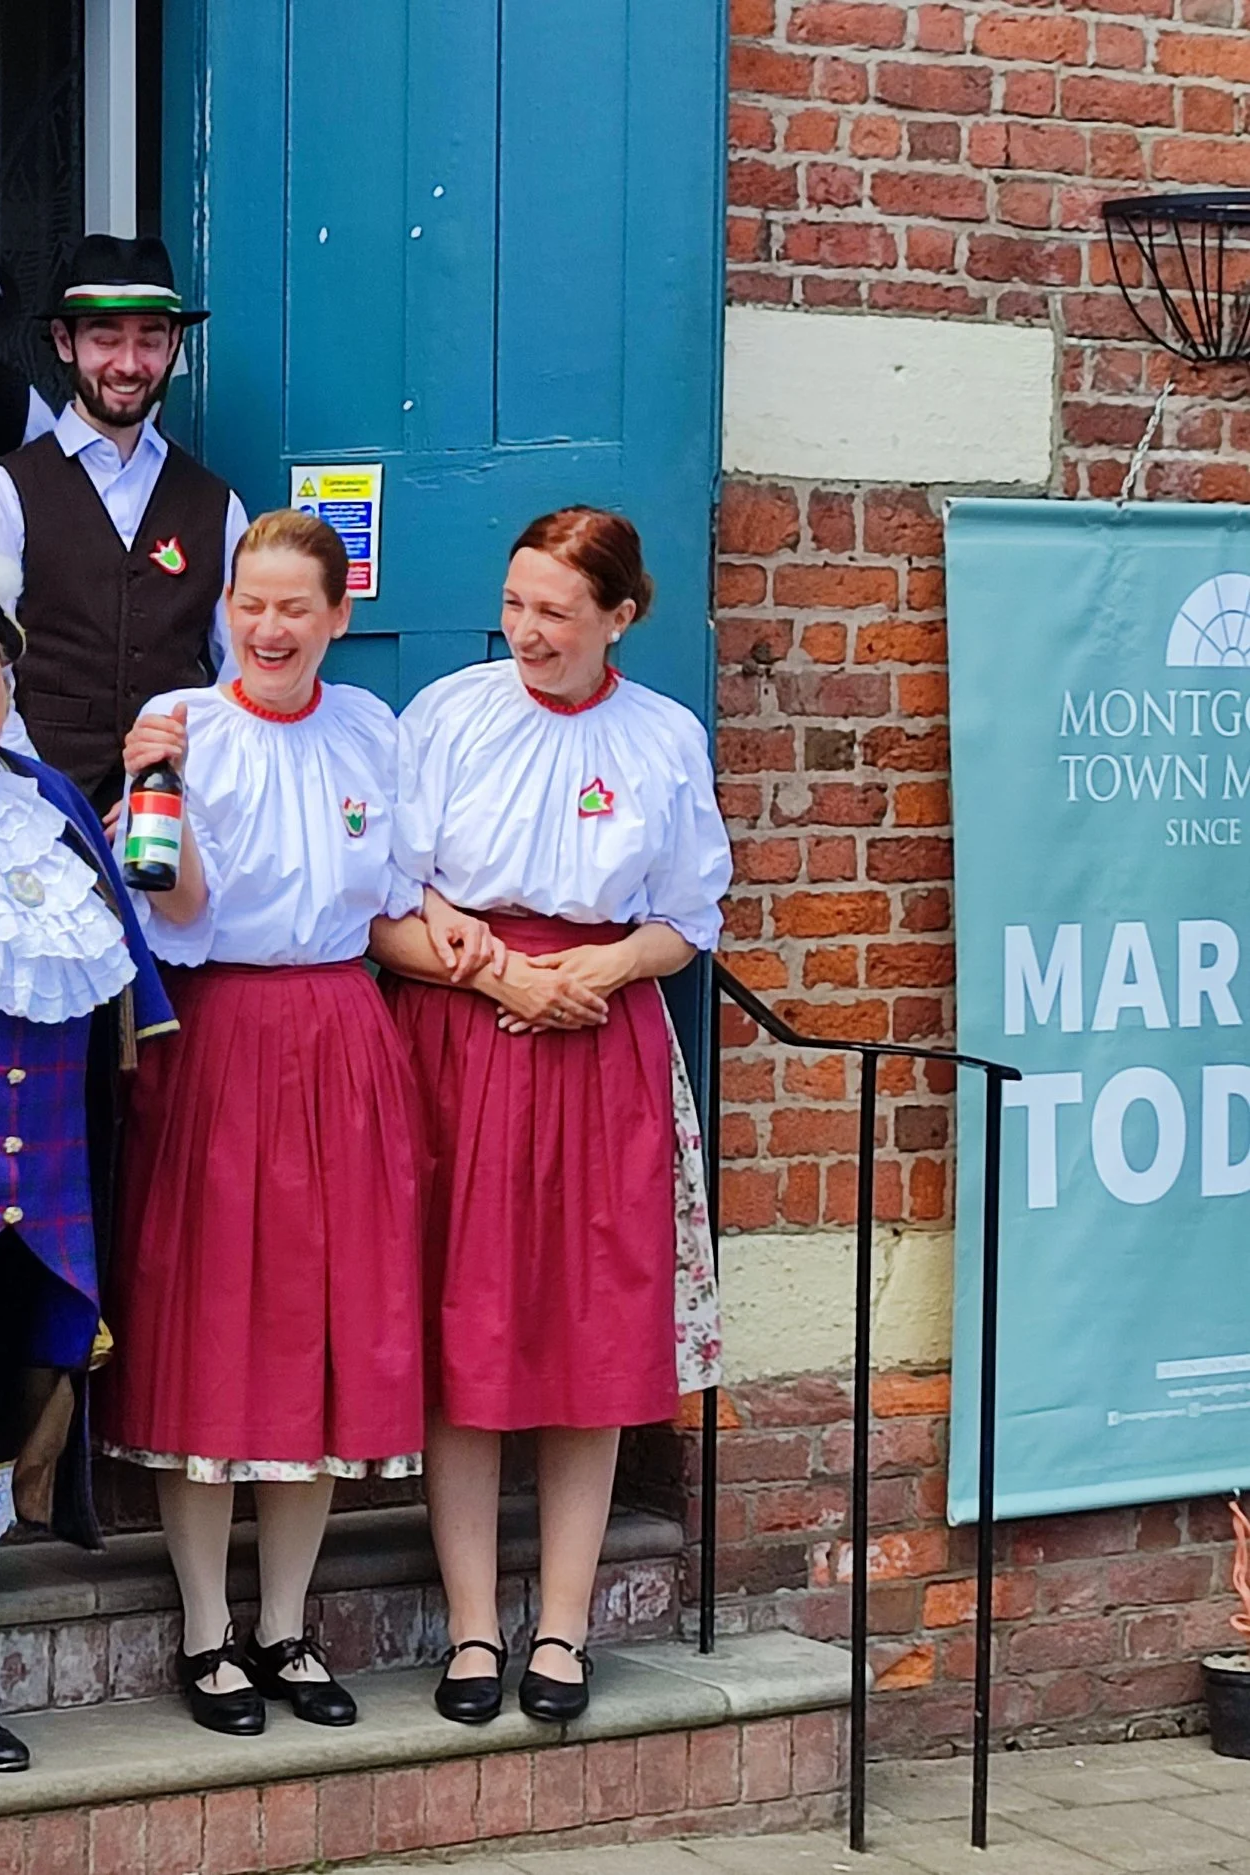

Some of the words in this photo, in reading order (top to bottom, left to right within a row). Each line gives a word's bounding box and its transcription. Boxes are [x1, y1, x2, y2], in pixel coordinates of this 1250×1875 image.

[1059, 689, 1250, 738] MONTG
[1058, 754, 1209, 802] TOWN
[1165, 818, 1242, 846] SINCE
[1004, 919, 1243, 1036] MAR
